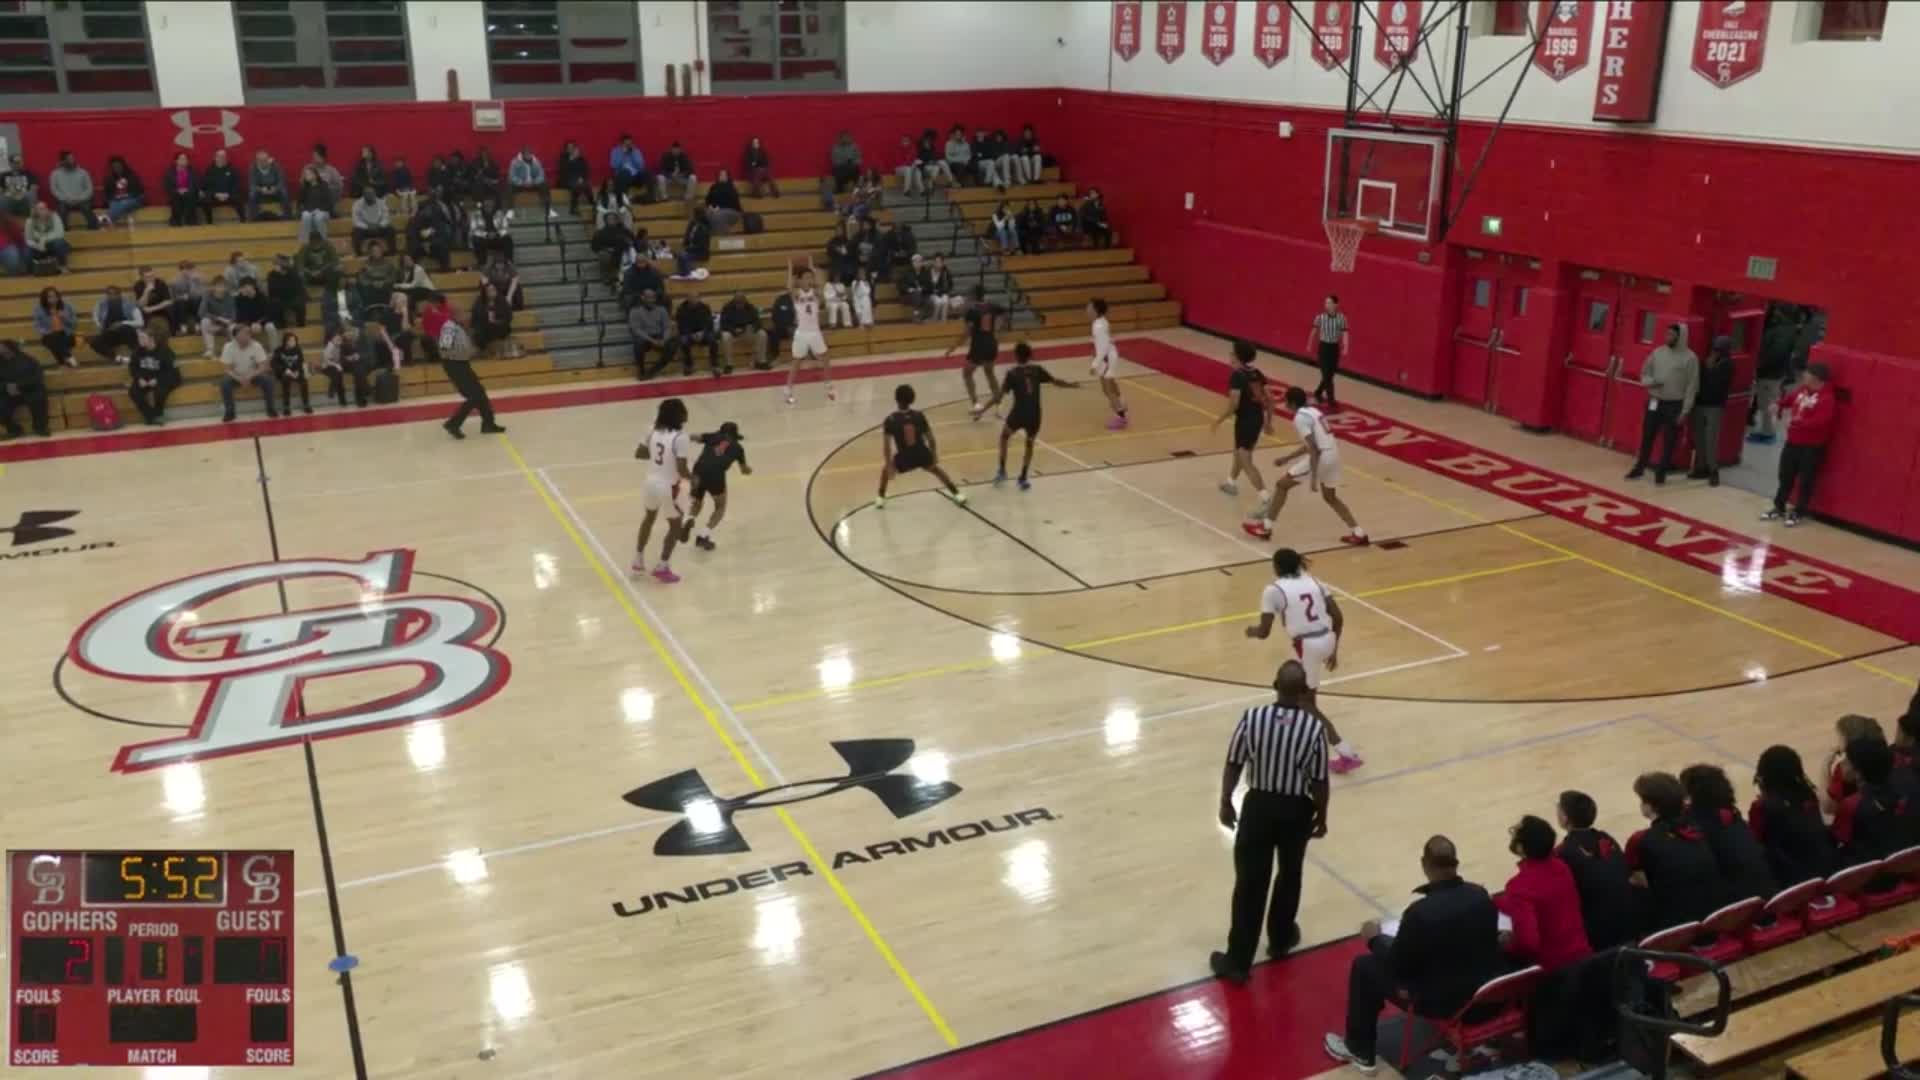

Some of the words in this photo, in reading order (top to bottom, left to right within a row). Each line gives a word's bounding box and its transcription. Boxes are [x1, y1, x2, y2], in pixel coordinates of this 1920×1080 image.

[1544, 38, 1577, 57] 1999
[1707, 41, 1746, 62] 2021
[655, 441, 665, 466] 3
[1425, 452, 1854, 596] BURNIE
[1299, 593, 1320, 622] 2
[611, 859, 814, 919] UNDER
[831, 807, 1057, 870] ARMOUR
